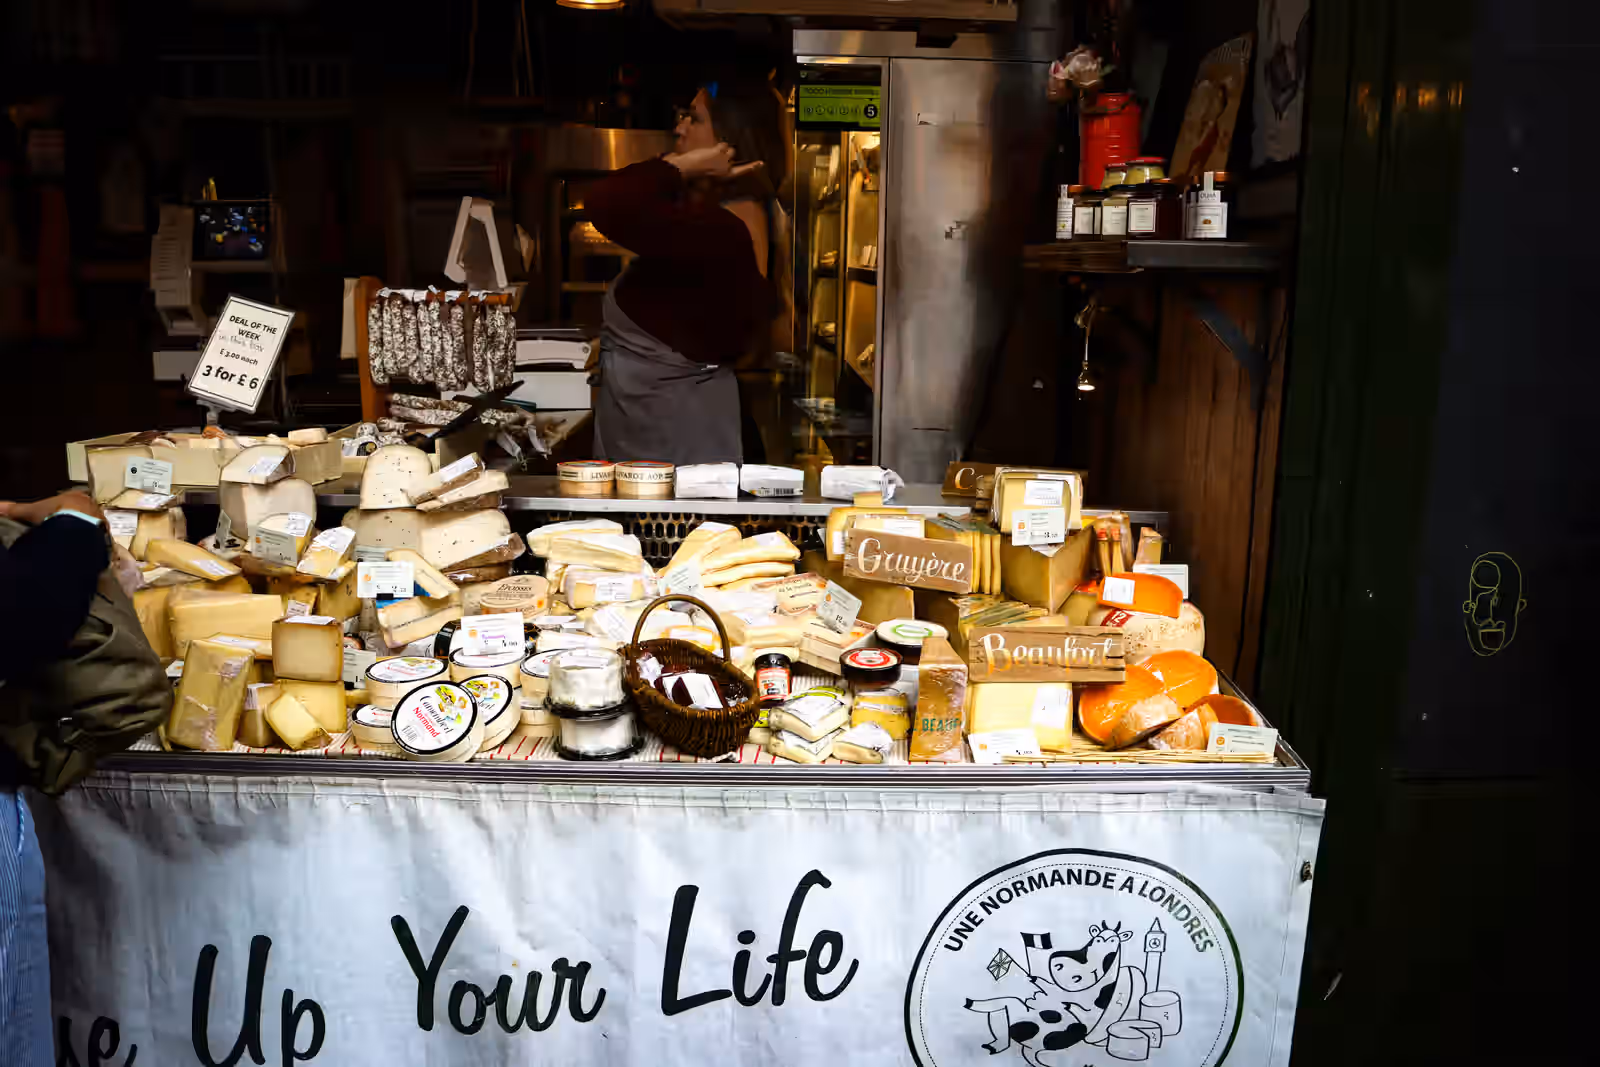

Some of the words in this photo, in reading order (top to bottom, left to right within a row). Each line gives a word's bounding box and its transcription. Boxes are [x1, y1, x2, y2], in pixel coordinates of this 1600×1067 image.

[867, 106, 875, 117] 5
[229, 315, 249, 327] DEAL
[250, 321, 262, 330] OF
[262, 325, 277, 335] THE
[238, 328, 261, 341] WEEK
[225, 351, 240, 360] 3.00
[241, 355, 258, 366] each
[202, 365, 212, 377] 3
[214, 366, 236, 382] for
[237, 374, 248, 386] £
[249, 377, 259, 389] 6
[857, 537, 967, 583] Gruyère
[1111, 610, 1127, 623] 12
[977, 633, 1119, 677] Beaufort
[412, 706, 440, 738] Normand
[943, 911, 984, 953] UNE
[979, 867, 1117, 916] NORMANDE
[1118, 879, 1134, 894] A
[1140, 880, 1216, 953] LONDRES
[192, 935, 325, 1067] Up
[391, 906, 606, 1035] Your
[662, 870, 859, 1016] Life
